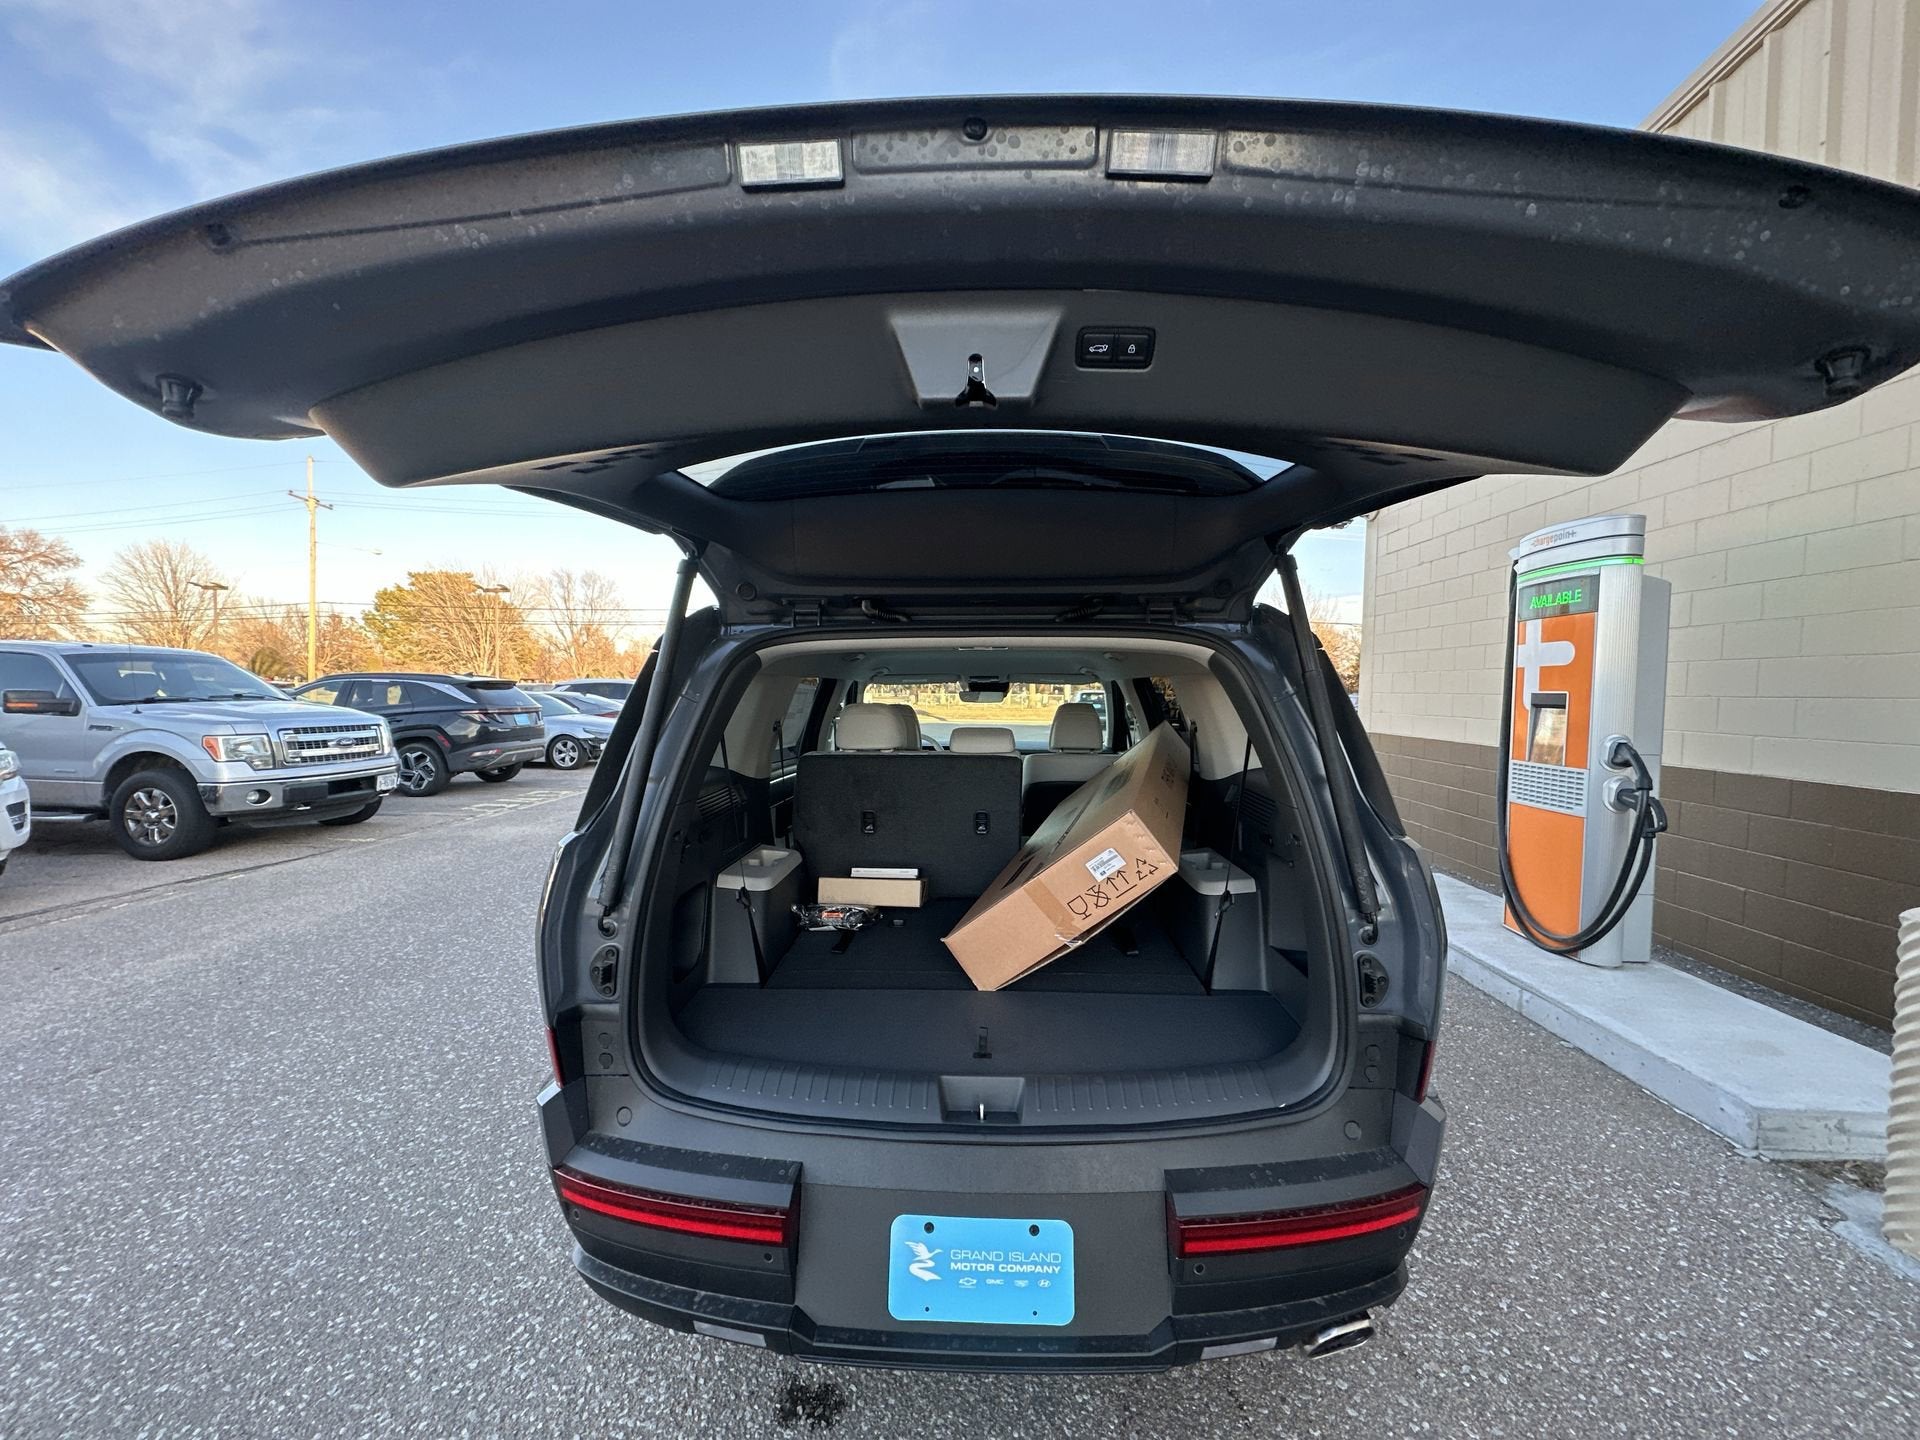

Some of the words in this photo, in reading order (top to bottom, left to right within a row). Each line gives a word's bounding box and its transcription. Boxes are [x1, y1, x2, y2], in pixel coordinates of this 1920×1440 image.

[1530, 589, 1582, 609] AVAILABLE
[950, 1249, 1003, 1262] GRAND
[1008, 1252, 1062, 1263] ISLAND
[950, 1262, 995, 1272] MOTOR
[999, 1264, 1061, 1274] COMPANY
